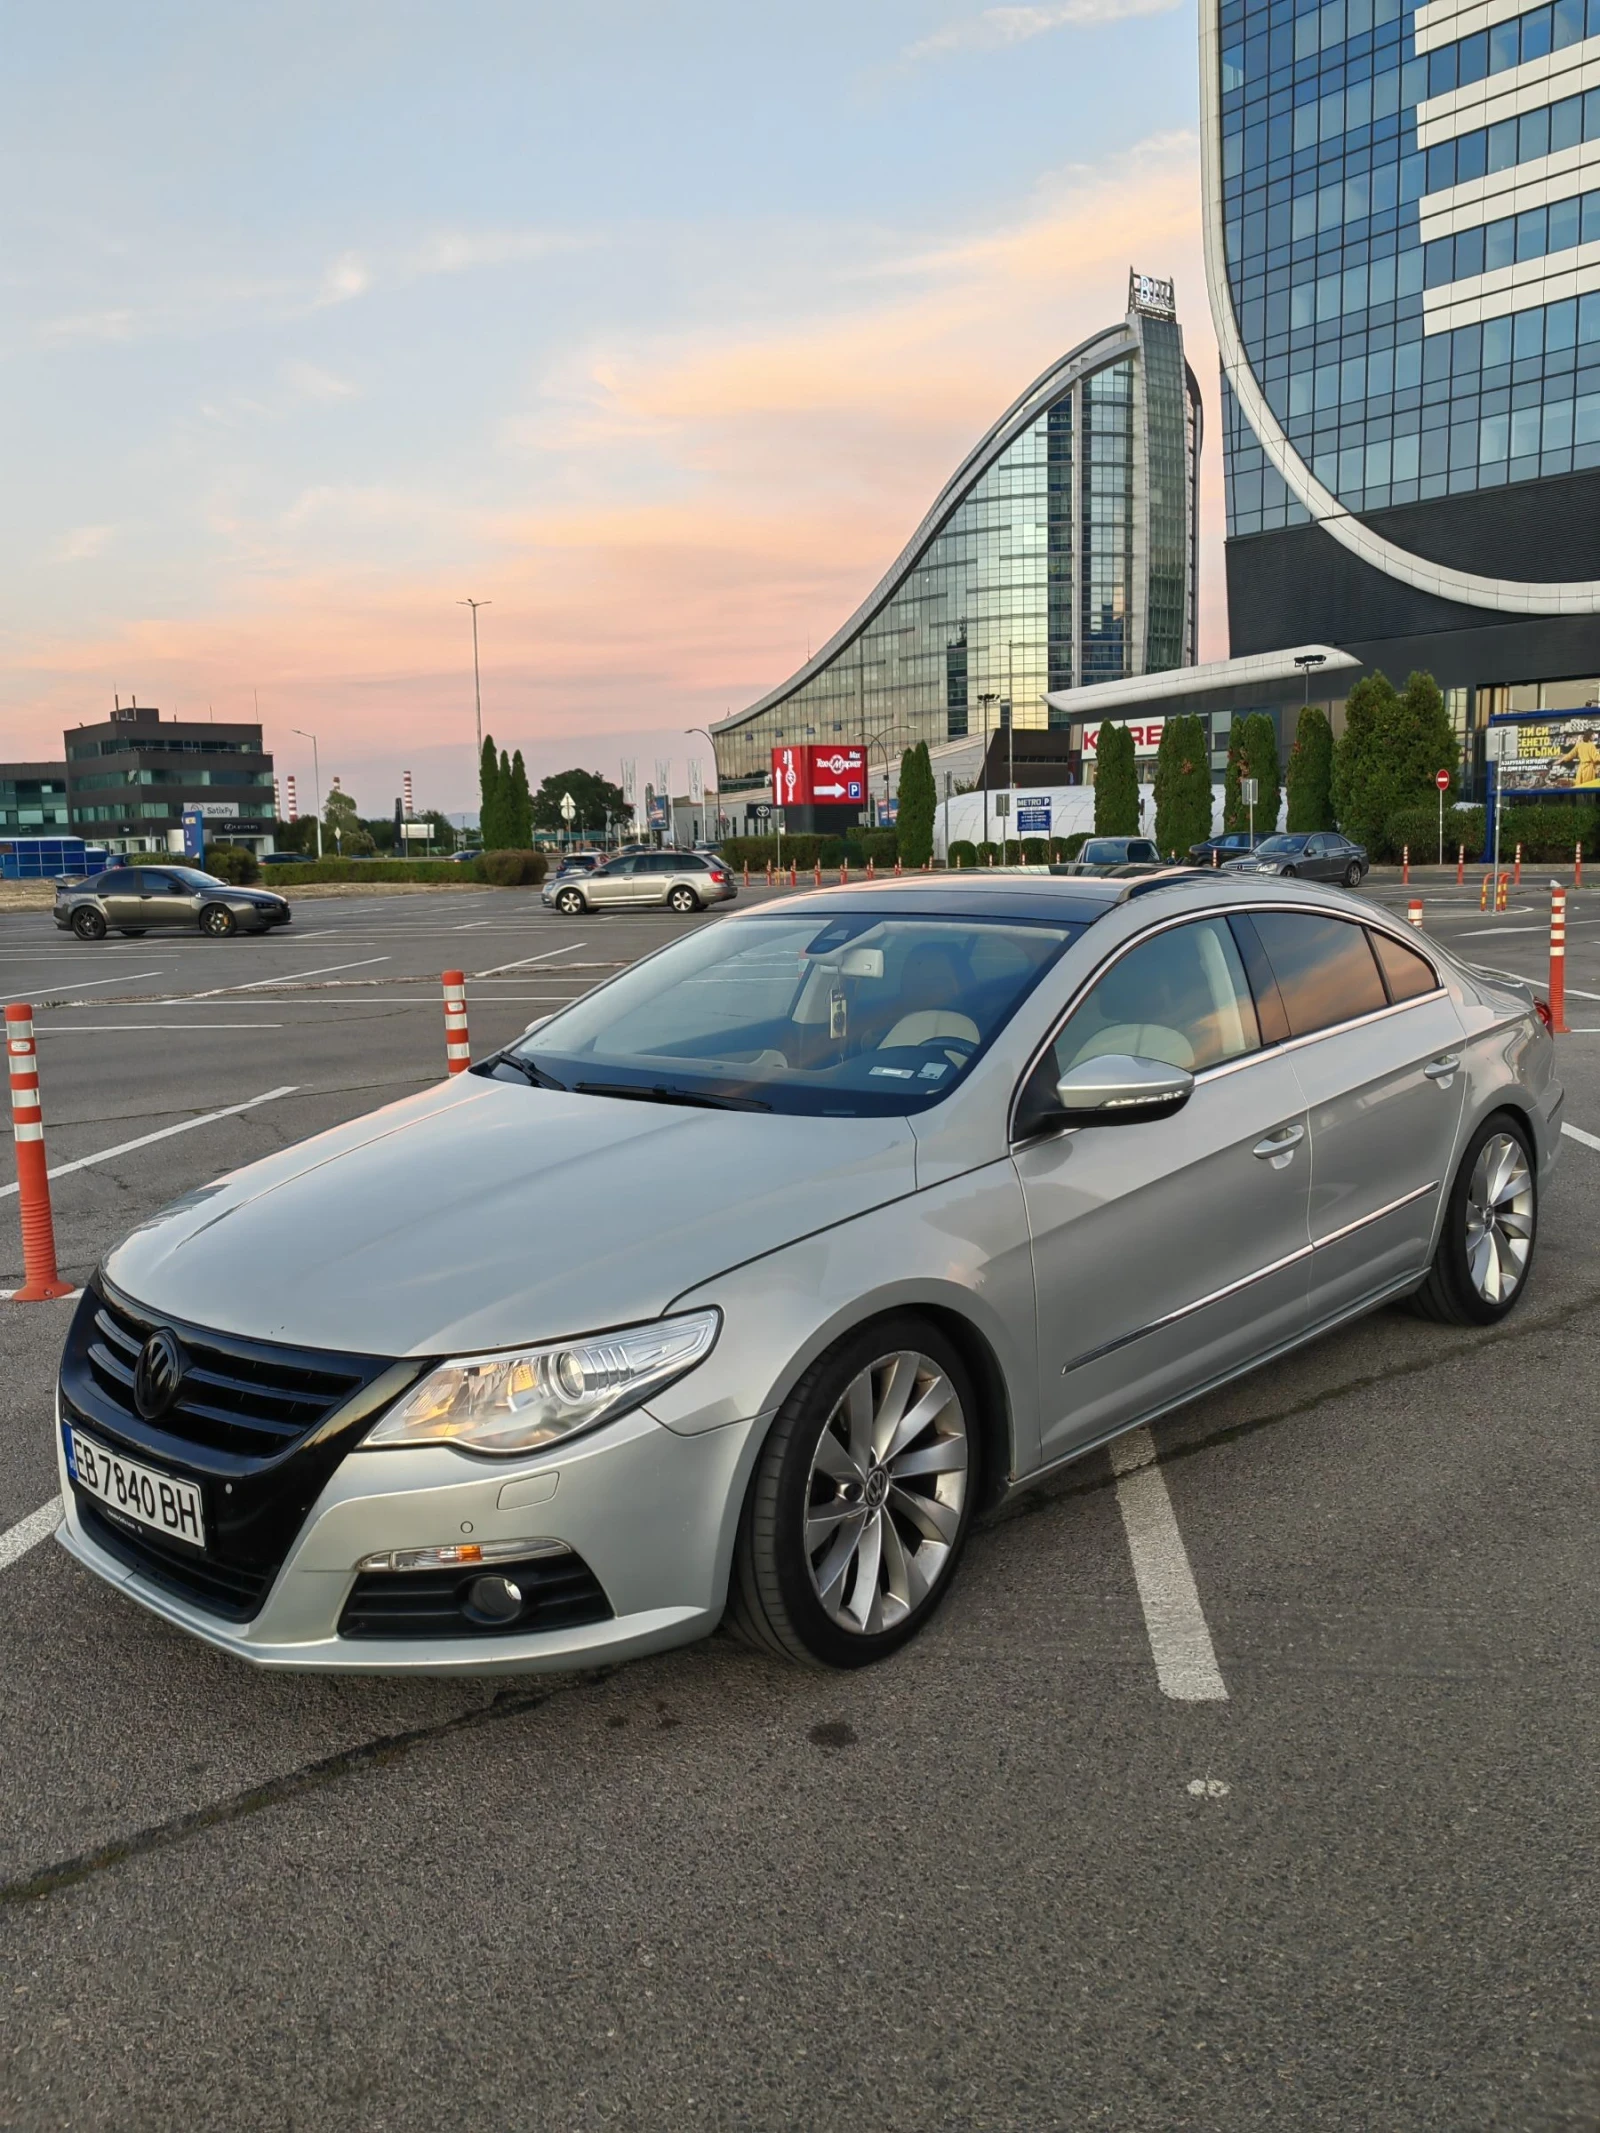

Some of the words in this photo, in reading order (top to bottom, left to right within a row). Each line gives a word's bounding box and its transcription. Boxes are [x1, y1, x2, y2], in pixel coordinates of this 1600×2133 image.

[1083, 725, 1163, 750] KRE
[1519, 746, 1562, 758] ТСТЪПКИ.
[1501, 758, 1525, 766] АЗАРУВАЙ
[207, 806, 233, 816] SatixFy
[73, 1436, 98, 1489] EB
[98, 1453, 156, 1519] 7840
[158, 1481, 199, 1538] BH
